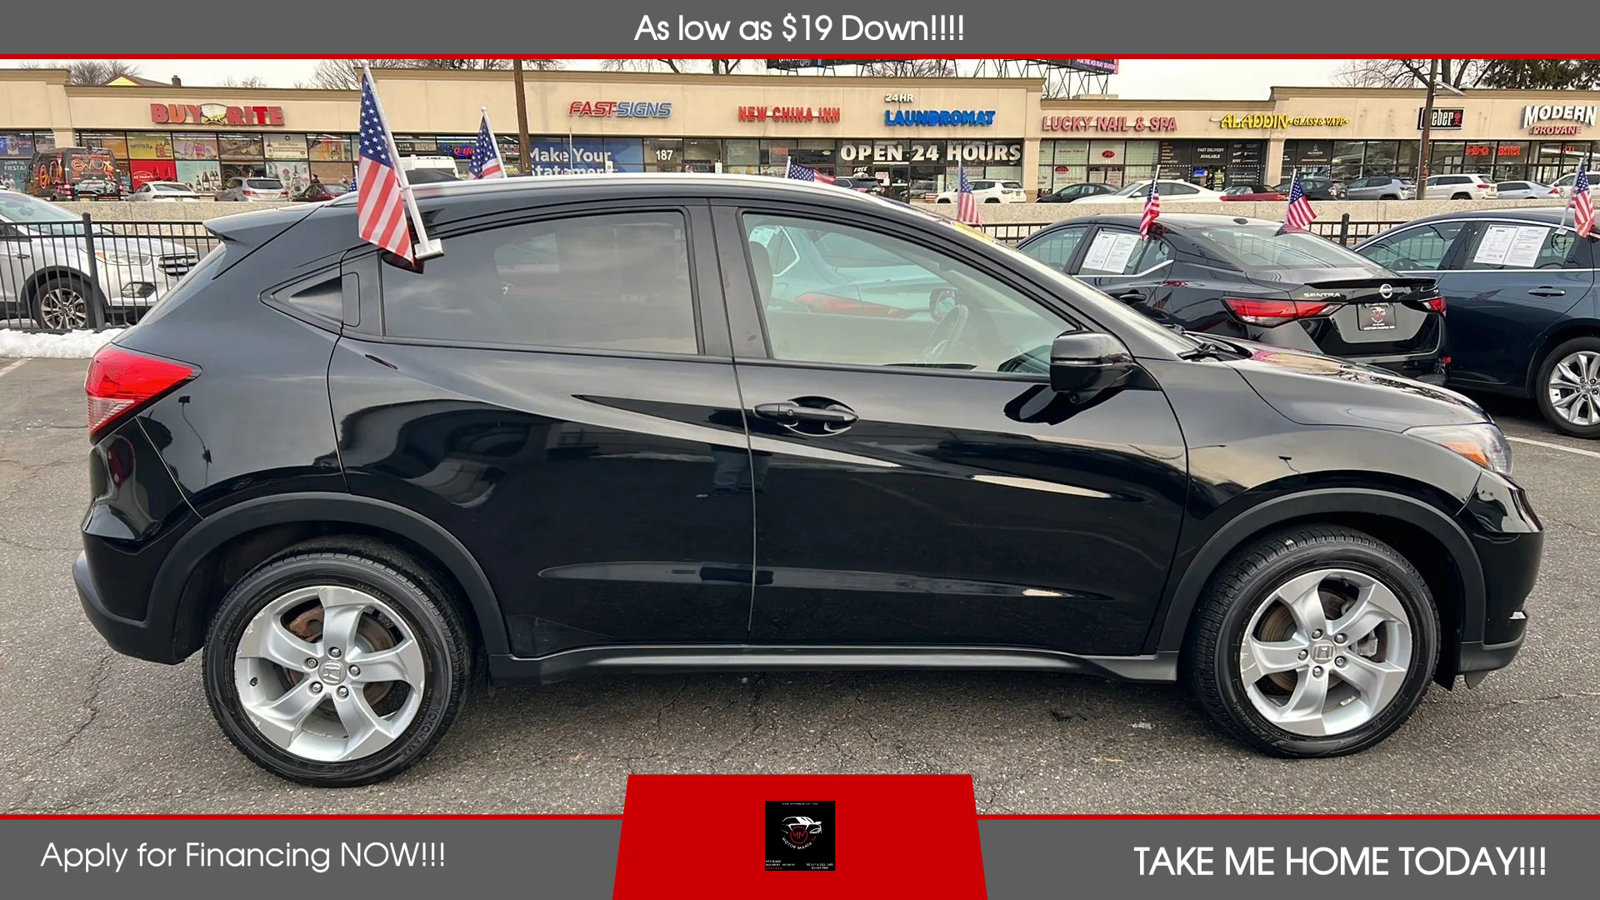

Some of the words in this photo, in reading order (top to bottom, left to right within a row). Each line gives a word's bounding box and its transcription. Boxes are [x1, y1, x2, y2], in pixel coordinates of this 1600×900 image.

[150, 103, 202, 124] BUY
[226, 106, 285, 126] RITE
[569, 101, 672, 118] FASTSIGNS
[738, 106, 767, 122] NEW
[772, 106, 813, 123] CHINA
[818, 107, 841, 123] INN
[885, 110, 996, 126] LAUNDROMAT
[1430, 109, 1455, 126] eber
[1522, 105, 1597, 129] MODERN
[1042, 116, 1094, 132] LUCKY
[1096, 116, 1130, 132] NAIL
[1135, 117, 1145, 131] &
[1150, 117, 1178, 132] SPA
[1220, 113, 1289, 130] ALADDIN
[530, 147, 570, 162] Make
[573, 148, 612, 162] Your
[656, 149, 673, 161] 187
[840, 145, 903, 161] OPEN
[910, 145, 939, 161] 24
[946, 144, 1022, 161] HOURS
